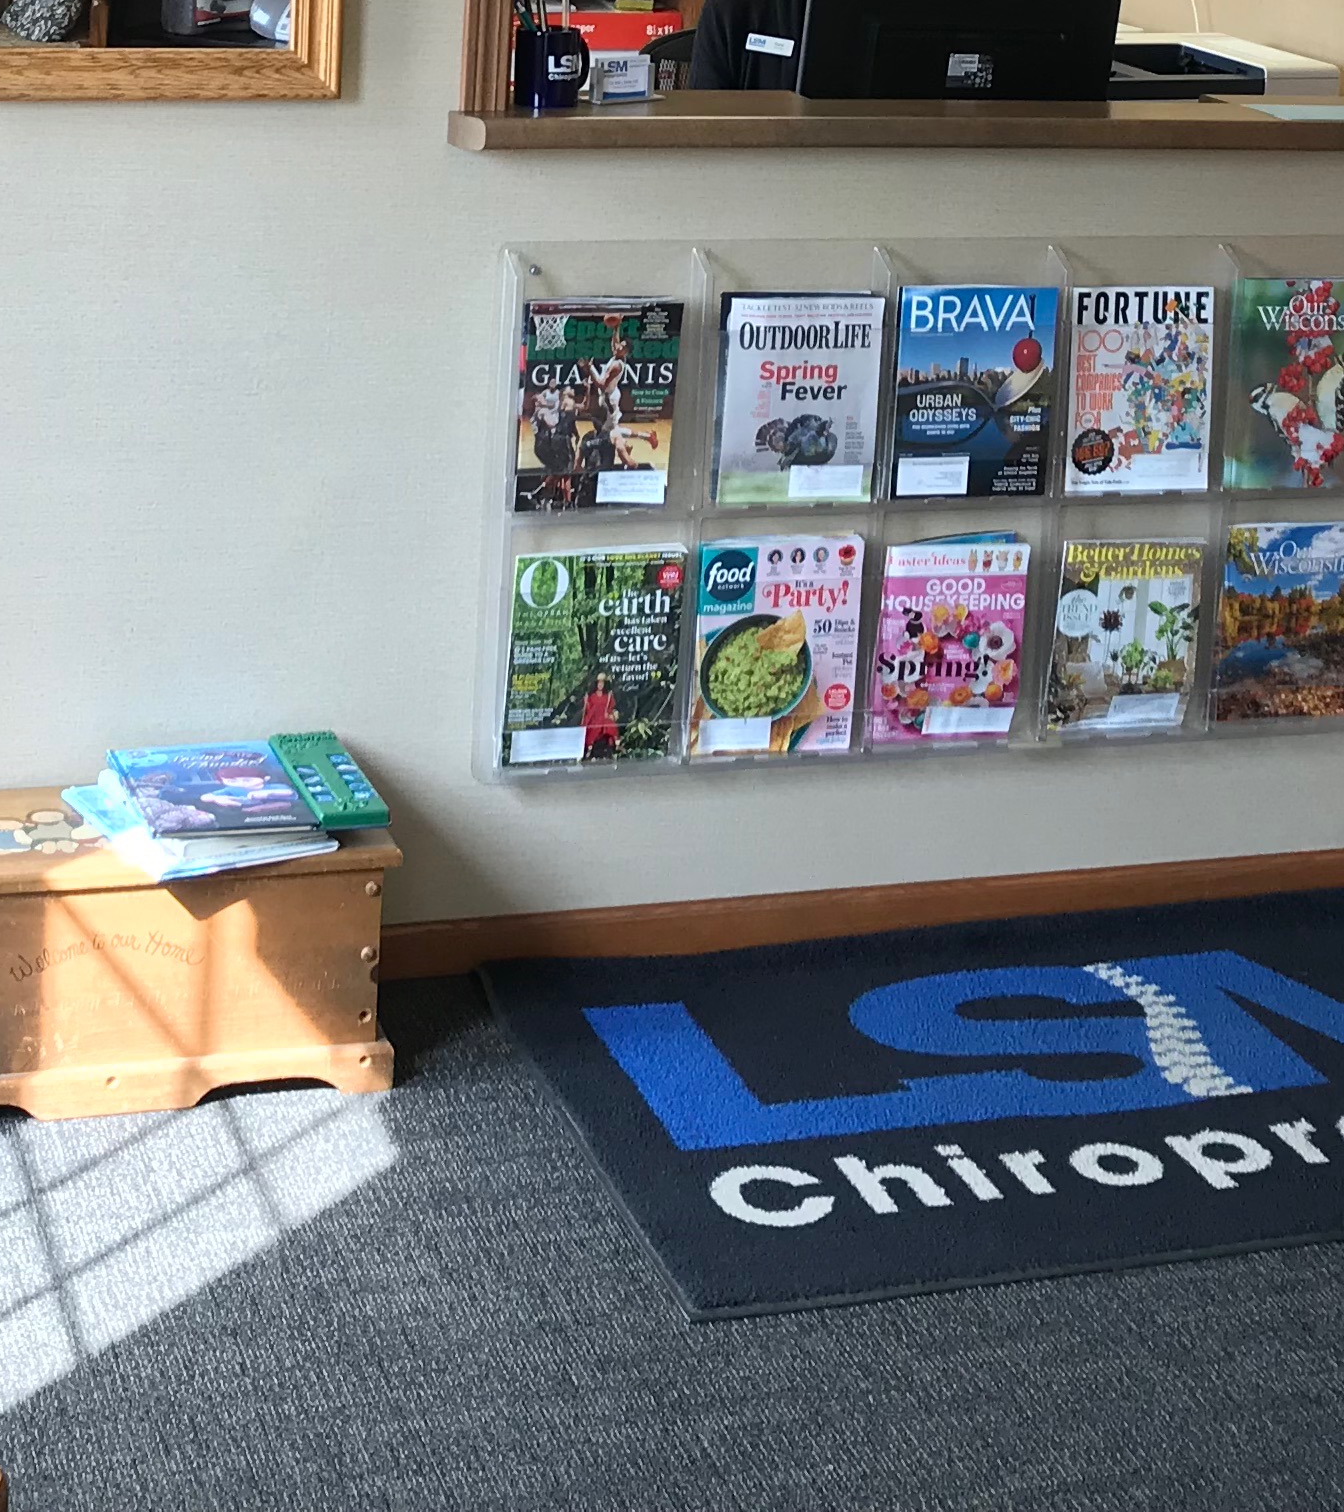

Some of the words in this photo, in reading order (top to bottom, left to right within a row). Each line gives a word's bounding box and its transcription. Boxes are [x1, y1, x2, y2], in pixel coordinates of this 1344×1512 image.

[601, 60, 628, 74] LSM
[910, 293, 1035, 333] BRAVA
[1077, 291, 1210, 326] FORTUNE
[1290, 295, 1328, 315] Our
[1077, 329, 1124, 353] 100
[759, 360, 838, 385] Spring
[781, 381, 847, 400] Fever
[917, 394, 962, 408] URBAN
[909, 408, 977, 422] ODYSSEYS
[1067, 543, 1131, 564] Better
[1131, 543, 1201, 560] Homes
[706, 561, 755, 592] food
[1080, 563, 1099, 583] &
[1099, 561, 1184, 580] Gardens
[520, 559, 570, 609] O
[926, 578, 986, 595] GOOD
[599, 589, 671, 616] earth
[703, 599, 753, 614] magazine
[762, 580, 849, 613] Party!
[813, 619, 832, 634] 50
[614, 633, 667, 653] care
[877, 653, 991, 682] Spring!
[9, 941, 89, 982] Welcome
[92, 934, 105, 950] to
[111, 934, 141, 950] our
[145, 930, 206, 966] Home
